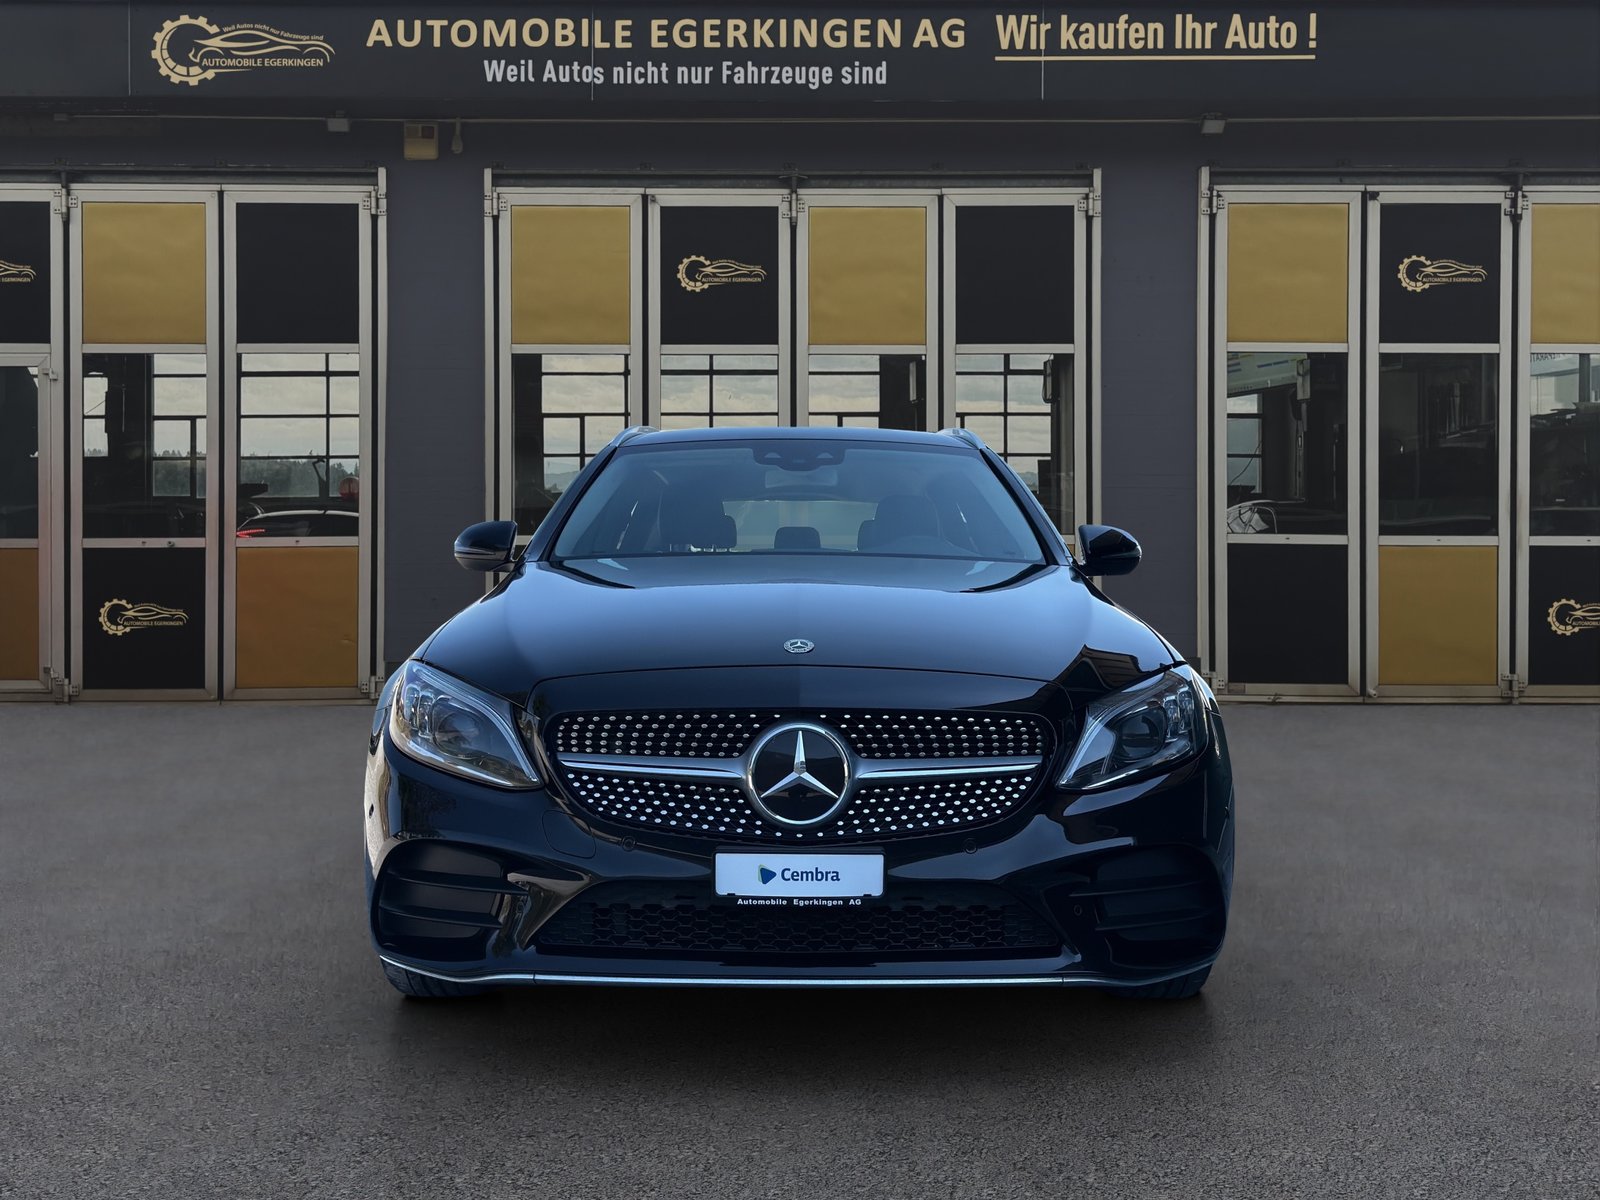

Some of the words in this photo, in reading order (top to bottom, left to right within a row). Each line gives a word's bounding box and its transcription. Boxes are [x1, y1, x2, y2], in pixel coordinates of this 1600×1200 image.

[280, 31, 310, 41] Fahrzeuge
[366, 18, 632, 49] AUTOMOBILE
[650, 18, 902, 49] EGERKINGEN
[912, 18, 965, 48] AG
[995, 14, 1052, 50] Wir
[1060, 13, 1164, 50] kaufen
[1174, 13, 1218, 49] Ihr
[1224, 13, 1298, 49] Auto
[1308, 12, 1317, 49] !
[201, 58, 263, 67] AUTOMOBILE
[264, 58, 324, 67] EGERKINGEN
[483, 59, 535, 83] Weil
[542, 59, 605, 84] Autos
[612, 60, 669, 85] nicht
[677, 66, 714, 84] nur
[722, 61, 833, 90] Fahrzeuge
[841, 60, 888, 85] sind
[780, 867, 841, 882] Cembra
[737, 898, 788, 906] Automobile
[793, 898, 844, 907] Egerkingen
[848, 898, 862, 906] AG
